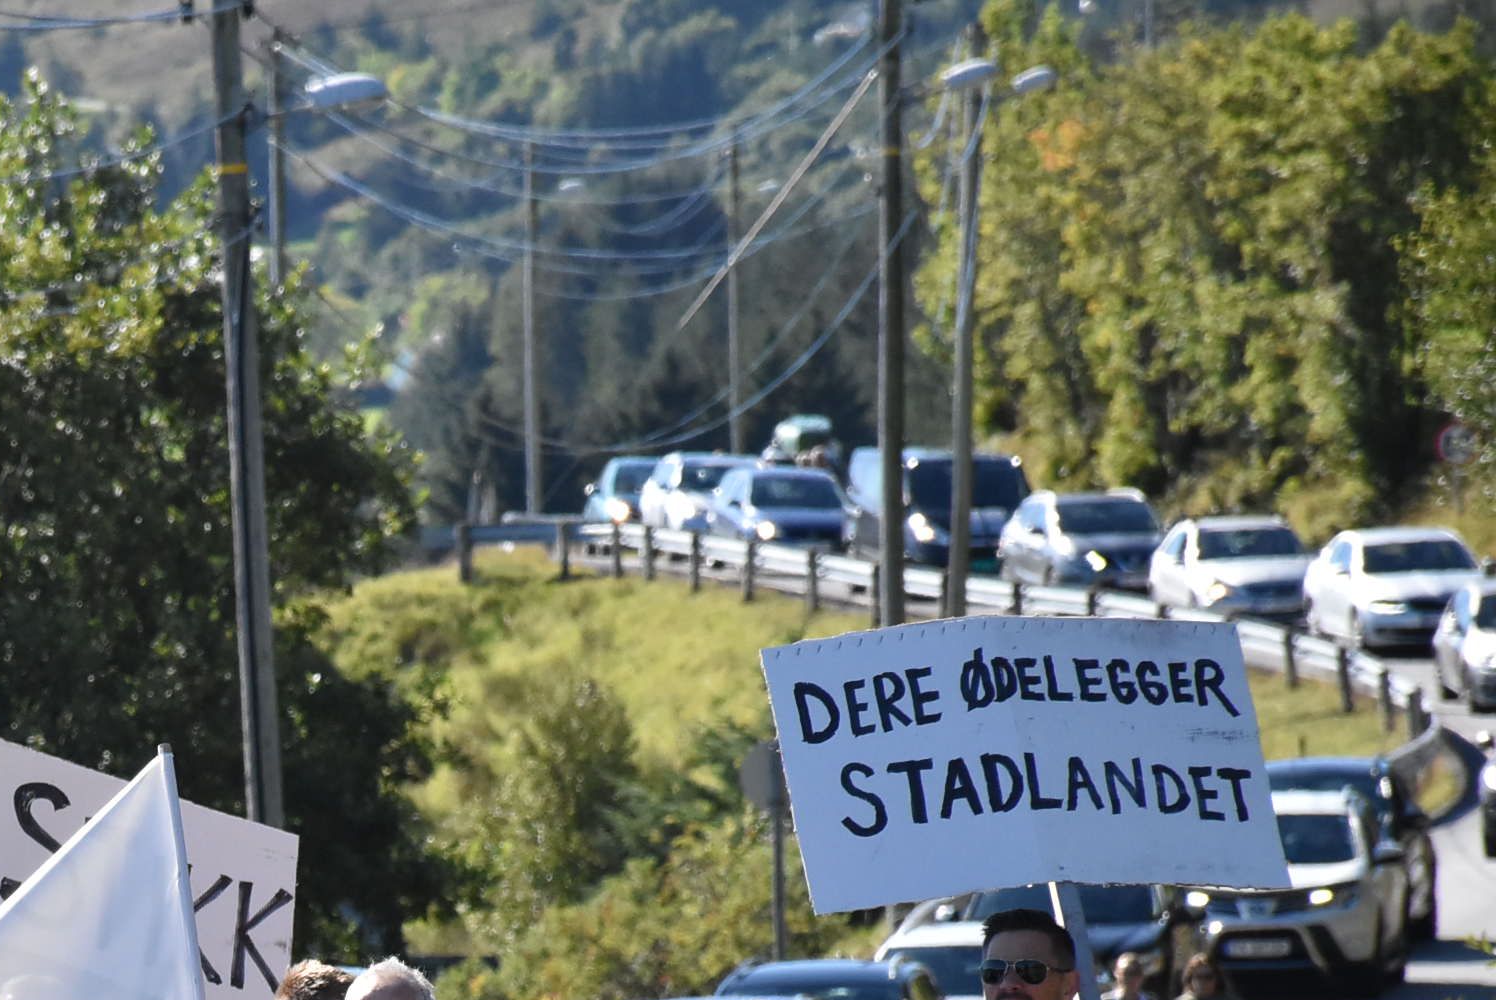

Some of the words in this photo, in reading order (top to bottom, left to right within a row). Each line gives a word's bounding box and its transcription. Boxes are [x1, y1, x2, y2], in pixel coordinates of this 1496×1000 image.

[793, 667, 943, 744] DERE
[960, 647, 1241, 718] ØDELEGGER
[840, 752, 1252, 838] STADLANDET
